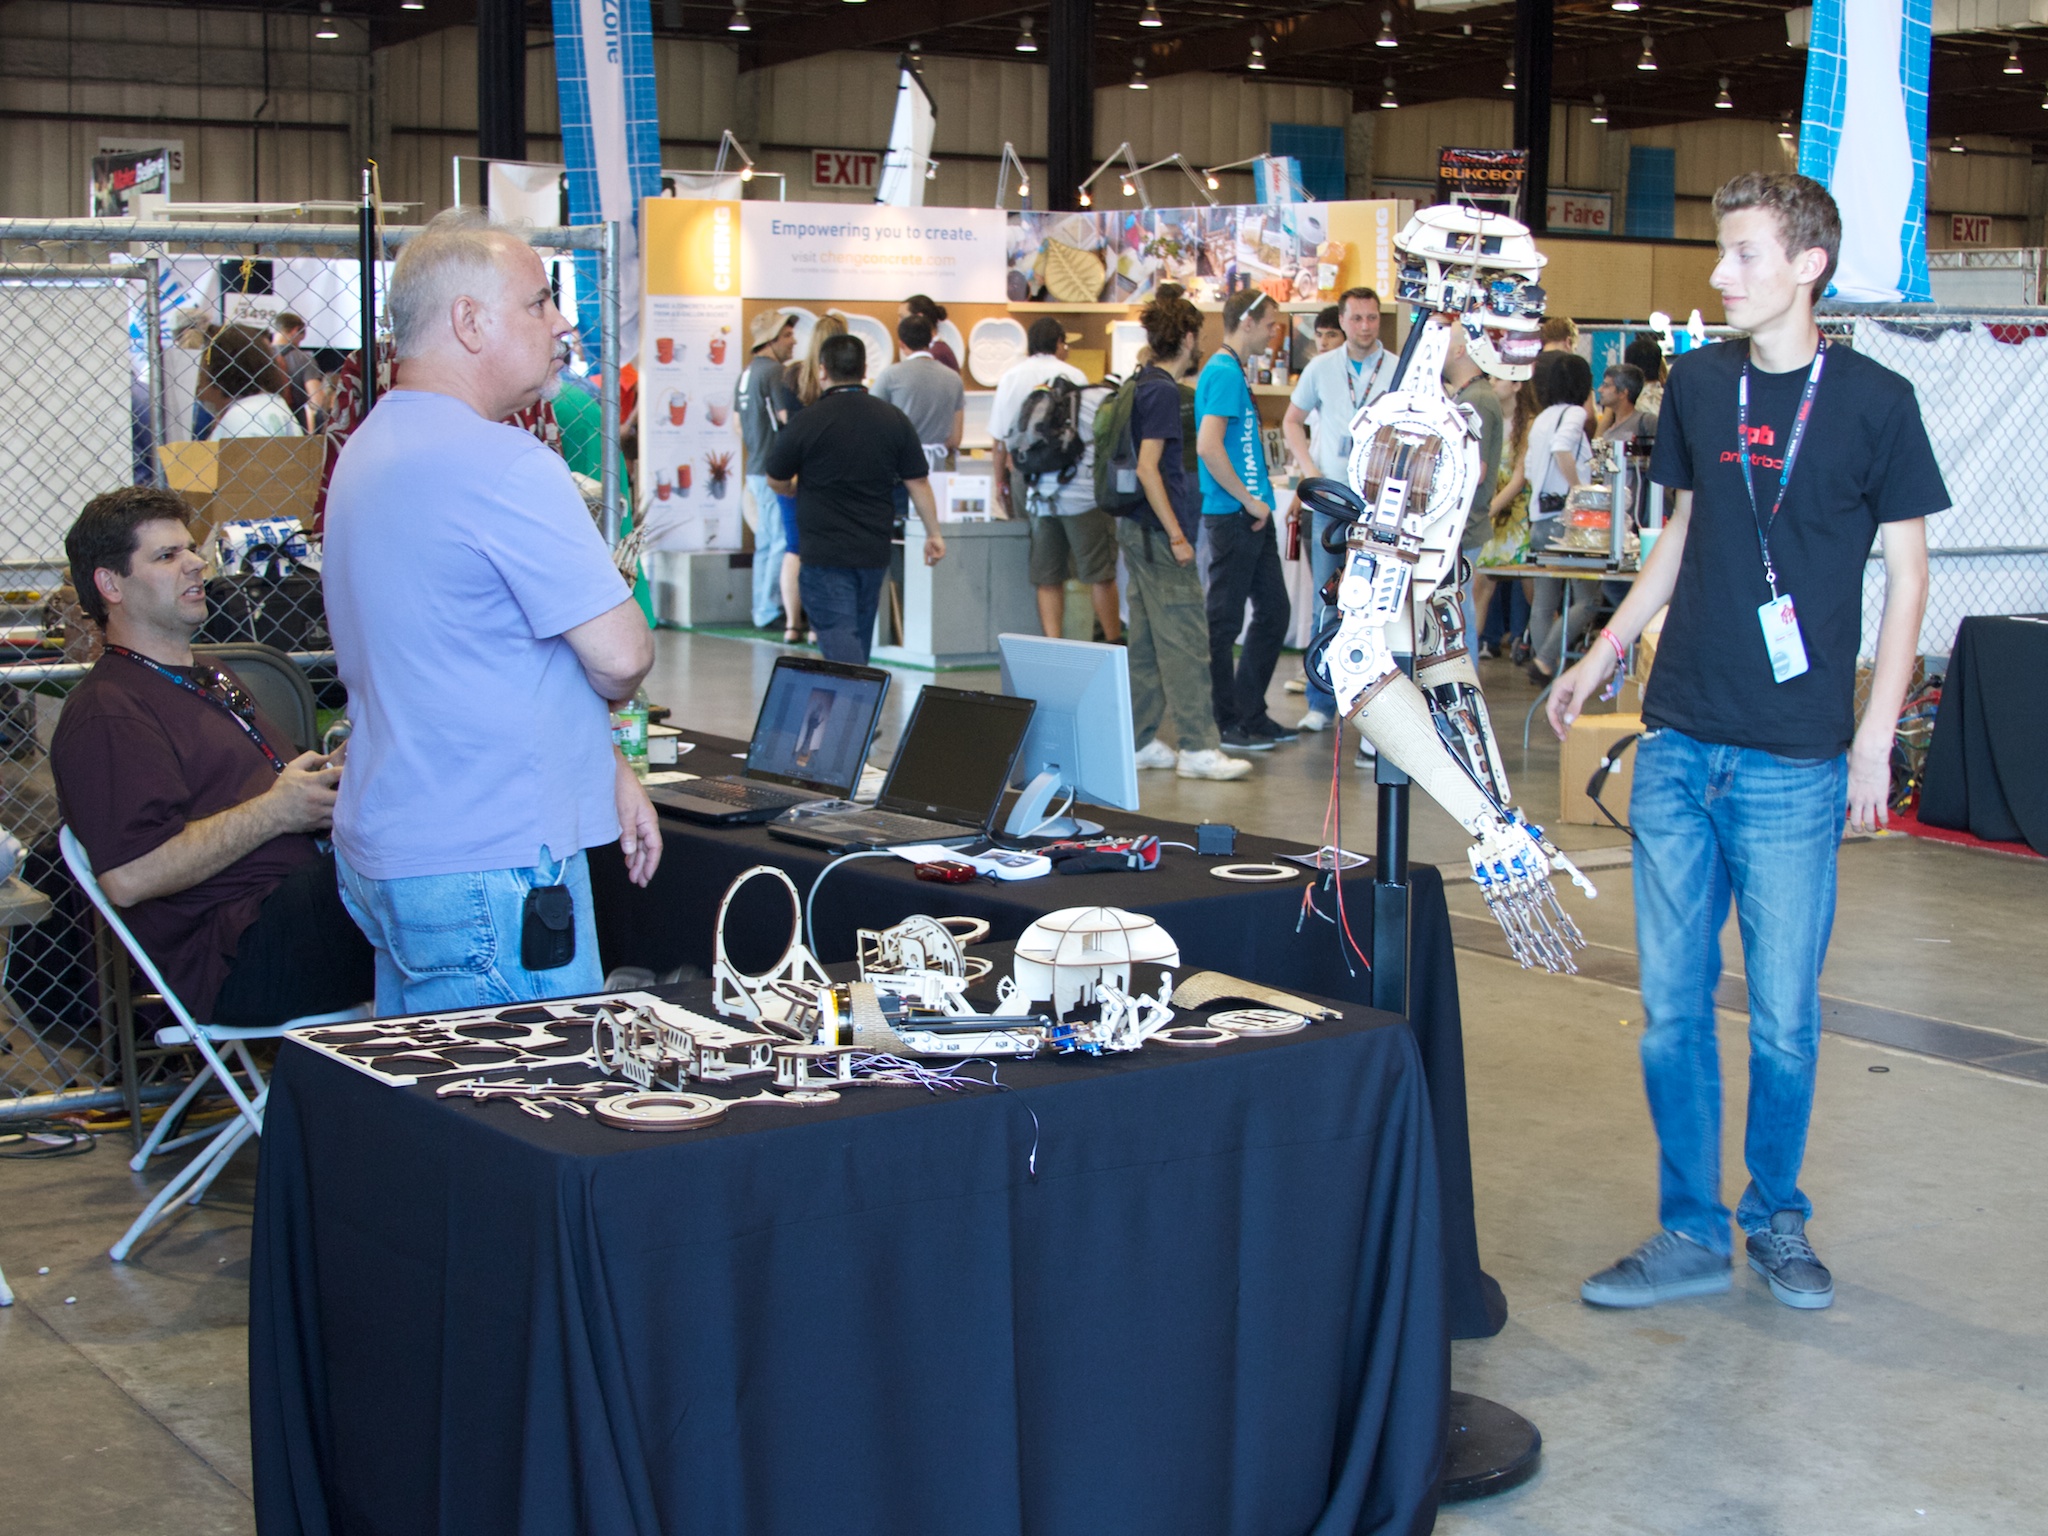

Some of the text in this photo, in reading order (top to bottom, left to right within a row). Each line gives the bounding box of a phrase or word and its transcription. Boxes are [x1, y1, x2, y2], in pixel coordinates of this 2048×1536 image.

[602, 0, 620, 64] Zone
[815, 154, 877, 187] EXIT
[1563, 201, 1605, 226] Faire
[771, 219, 978, 241] Empowering you to create.
[1953, 217, 1990, 242] EXIT
[714, 206, 731, 291] CHENG
[791, 250, 956, 267] visit chengconcrete.com
[1376, 207, 1389, 298] CHENG
